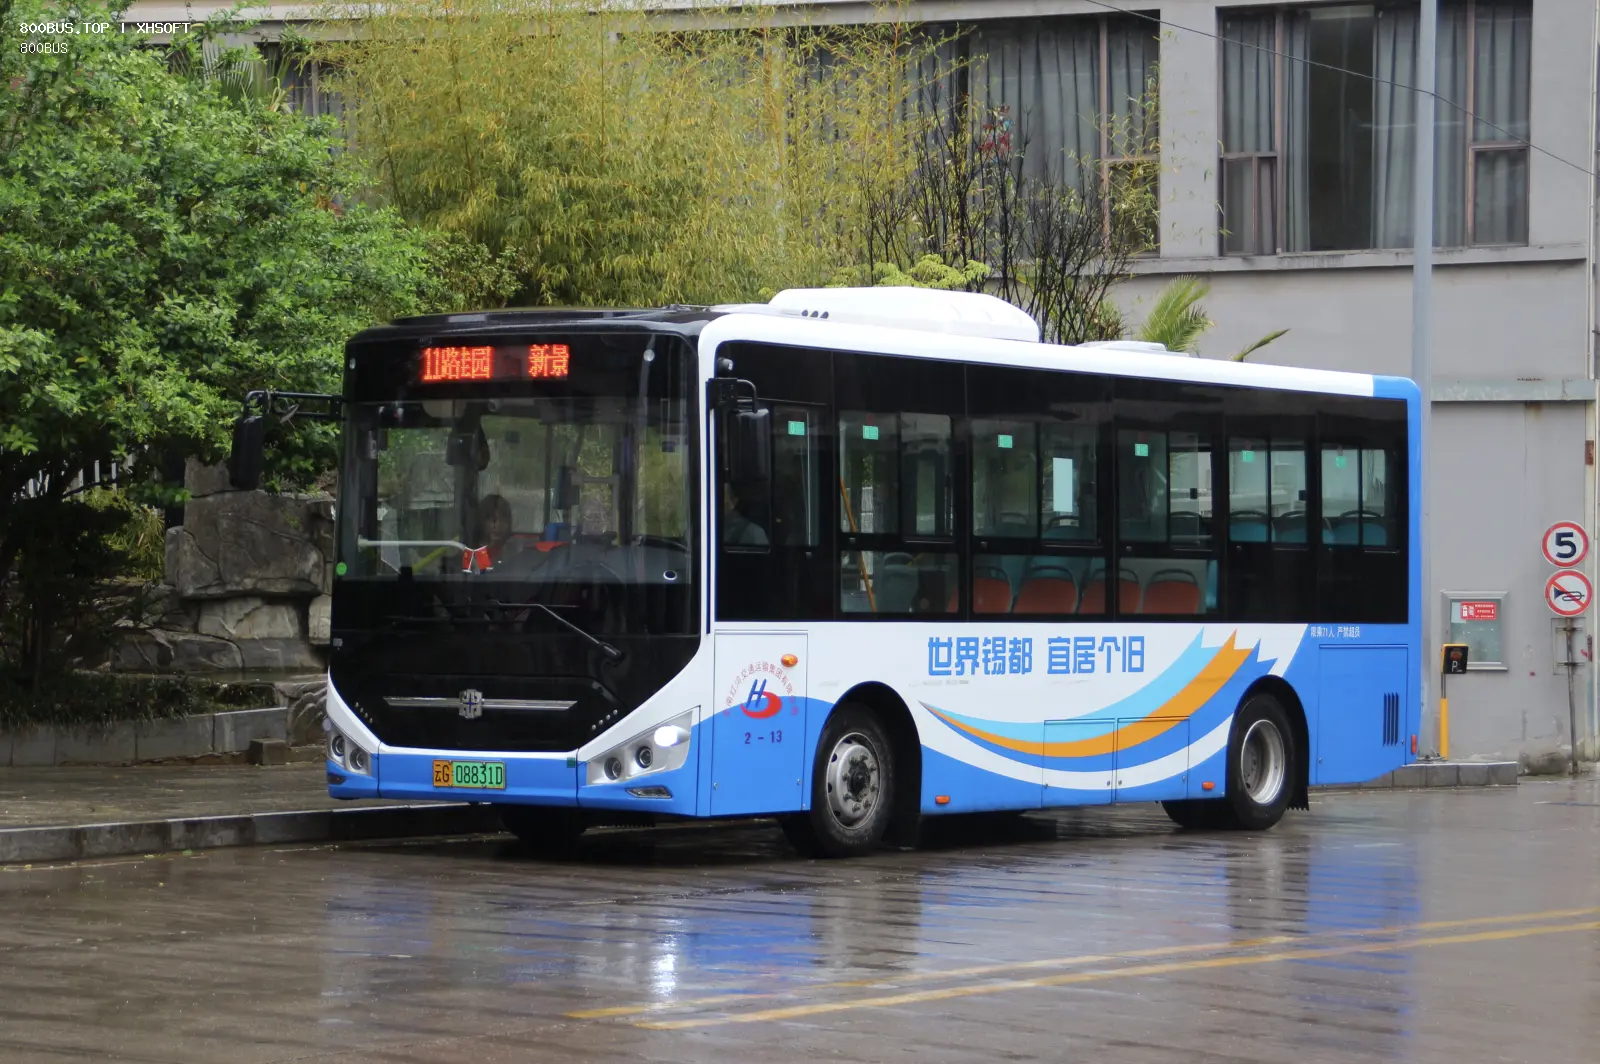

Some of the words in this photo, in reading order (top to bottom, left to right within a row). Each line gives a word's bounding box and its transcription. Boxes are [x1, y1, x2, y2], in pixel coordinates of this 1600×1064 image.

[1555, 532, 1577, 559] 5
[928, 636, 1033, 676] 世界锡都
[1047, 636, 1145, 675] 宜居个旧
